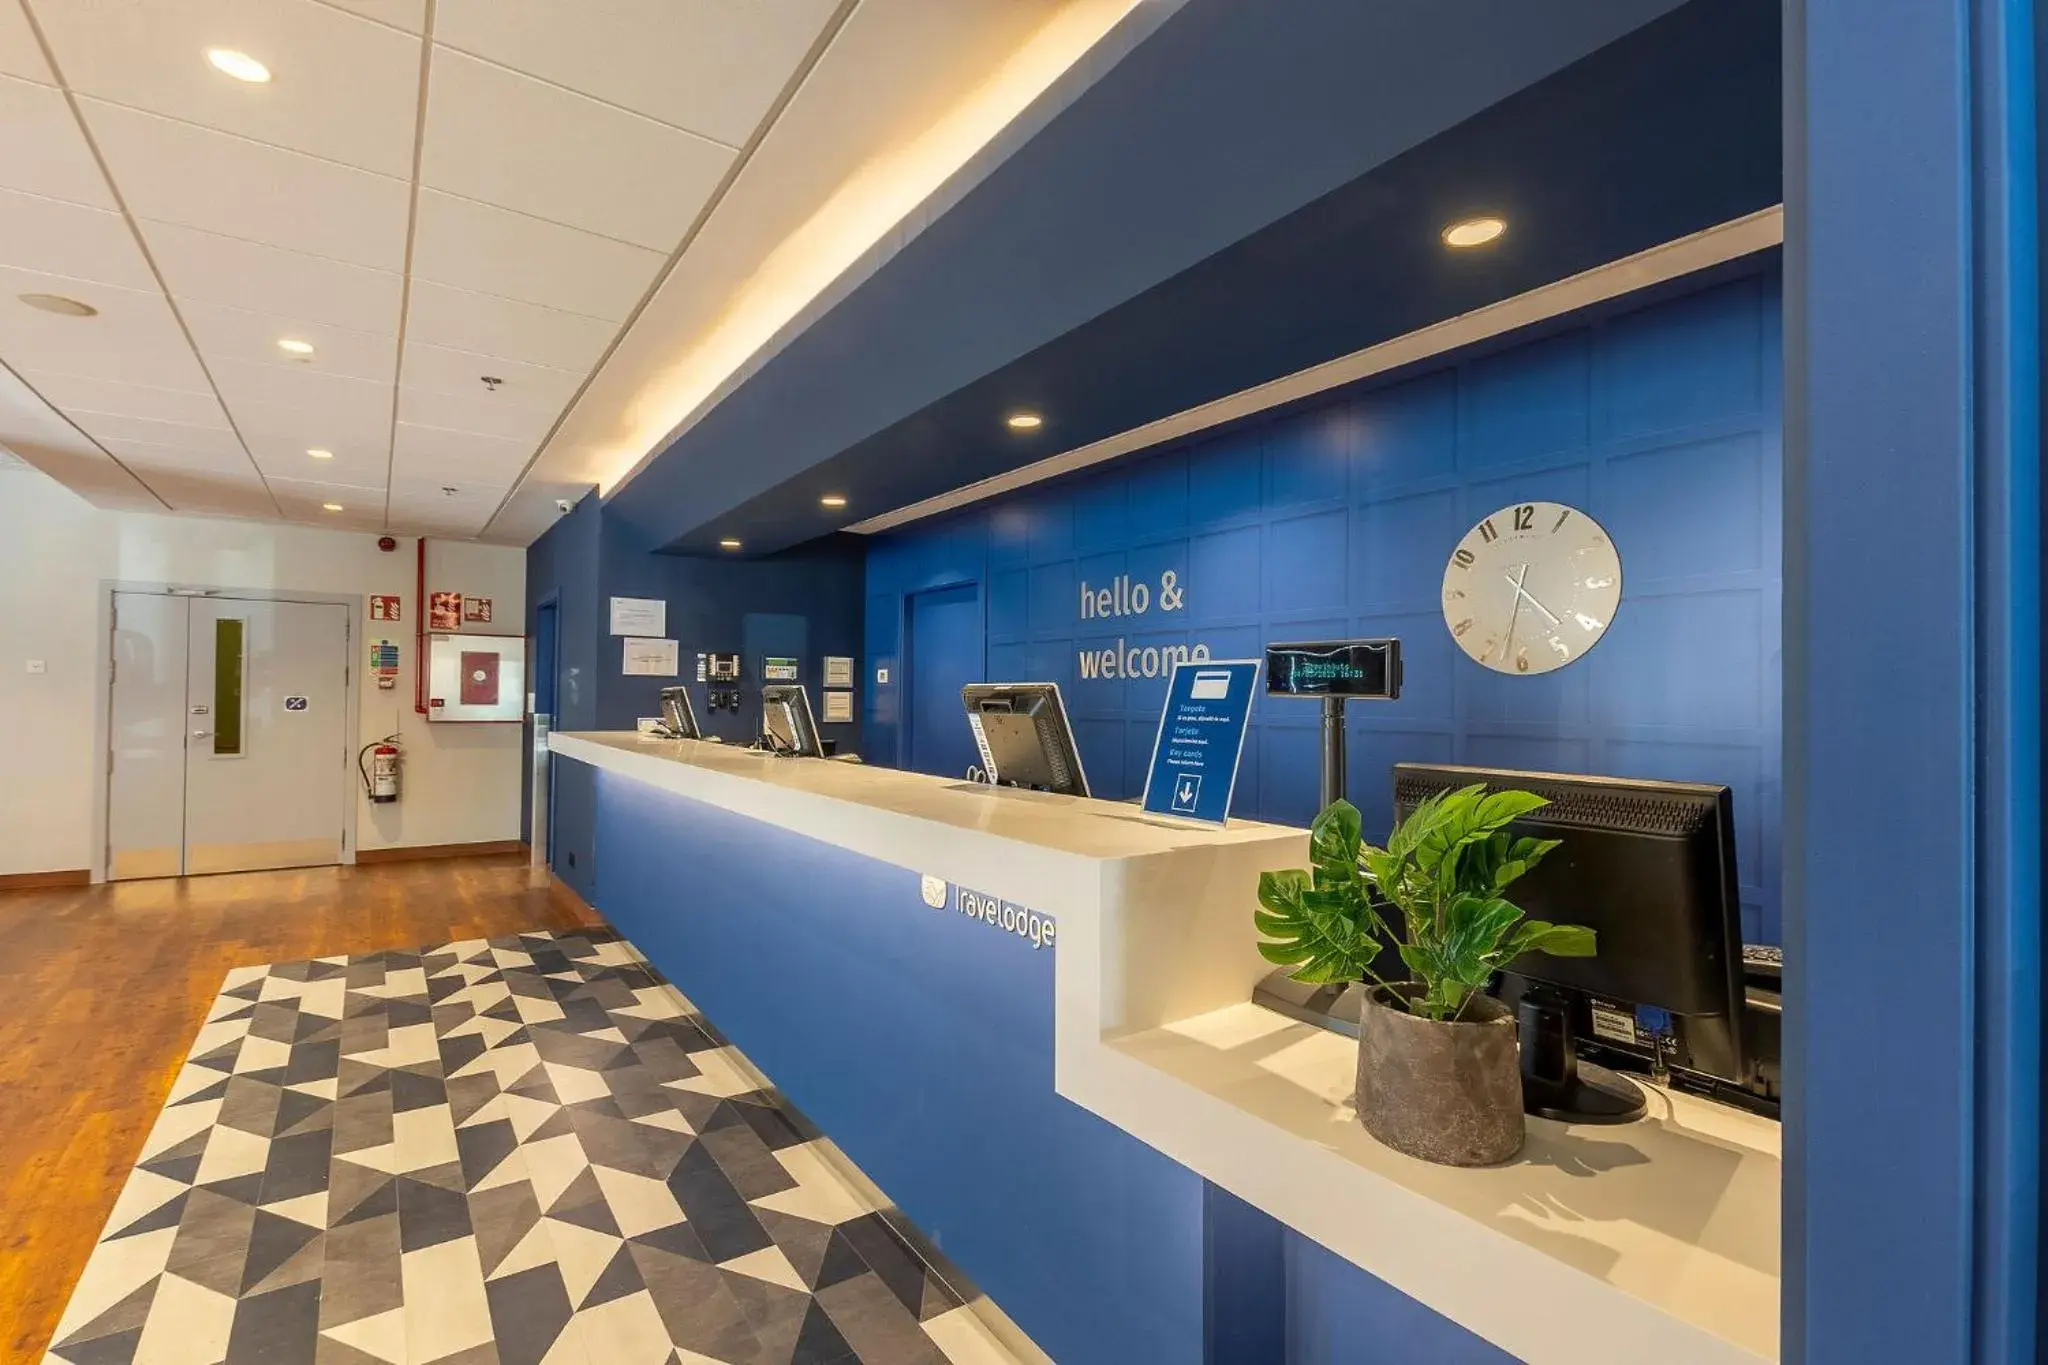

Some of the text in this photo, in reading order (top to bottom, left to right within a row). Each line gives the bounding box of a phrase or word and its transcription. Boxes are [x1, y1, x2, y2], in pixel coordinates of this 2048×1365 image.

[1477, 519, 1498, 543] 11
[1513, 505, 1535, 531] 12
[1552, 510, 1570, 534] 1
[1453, 549, 1476, 570] 10
[1080, 570, 1184, 619] hello &
[1574, 612, 1605, 632] 4
[1079, 638, 1210, 679] welcome
[1548, 636, 1570, 662] 5
[955, 885, 1056, 950] Travelodge
